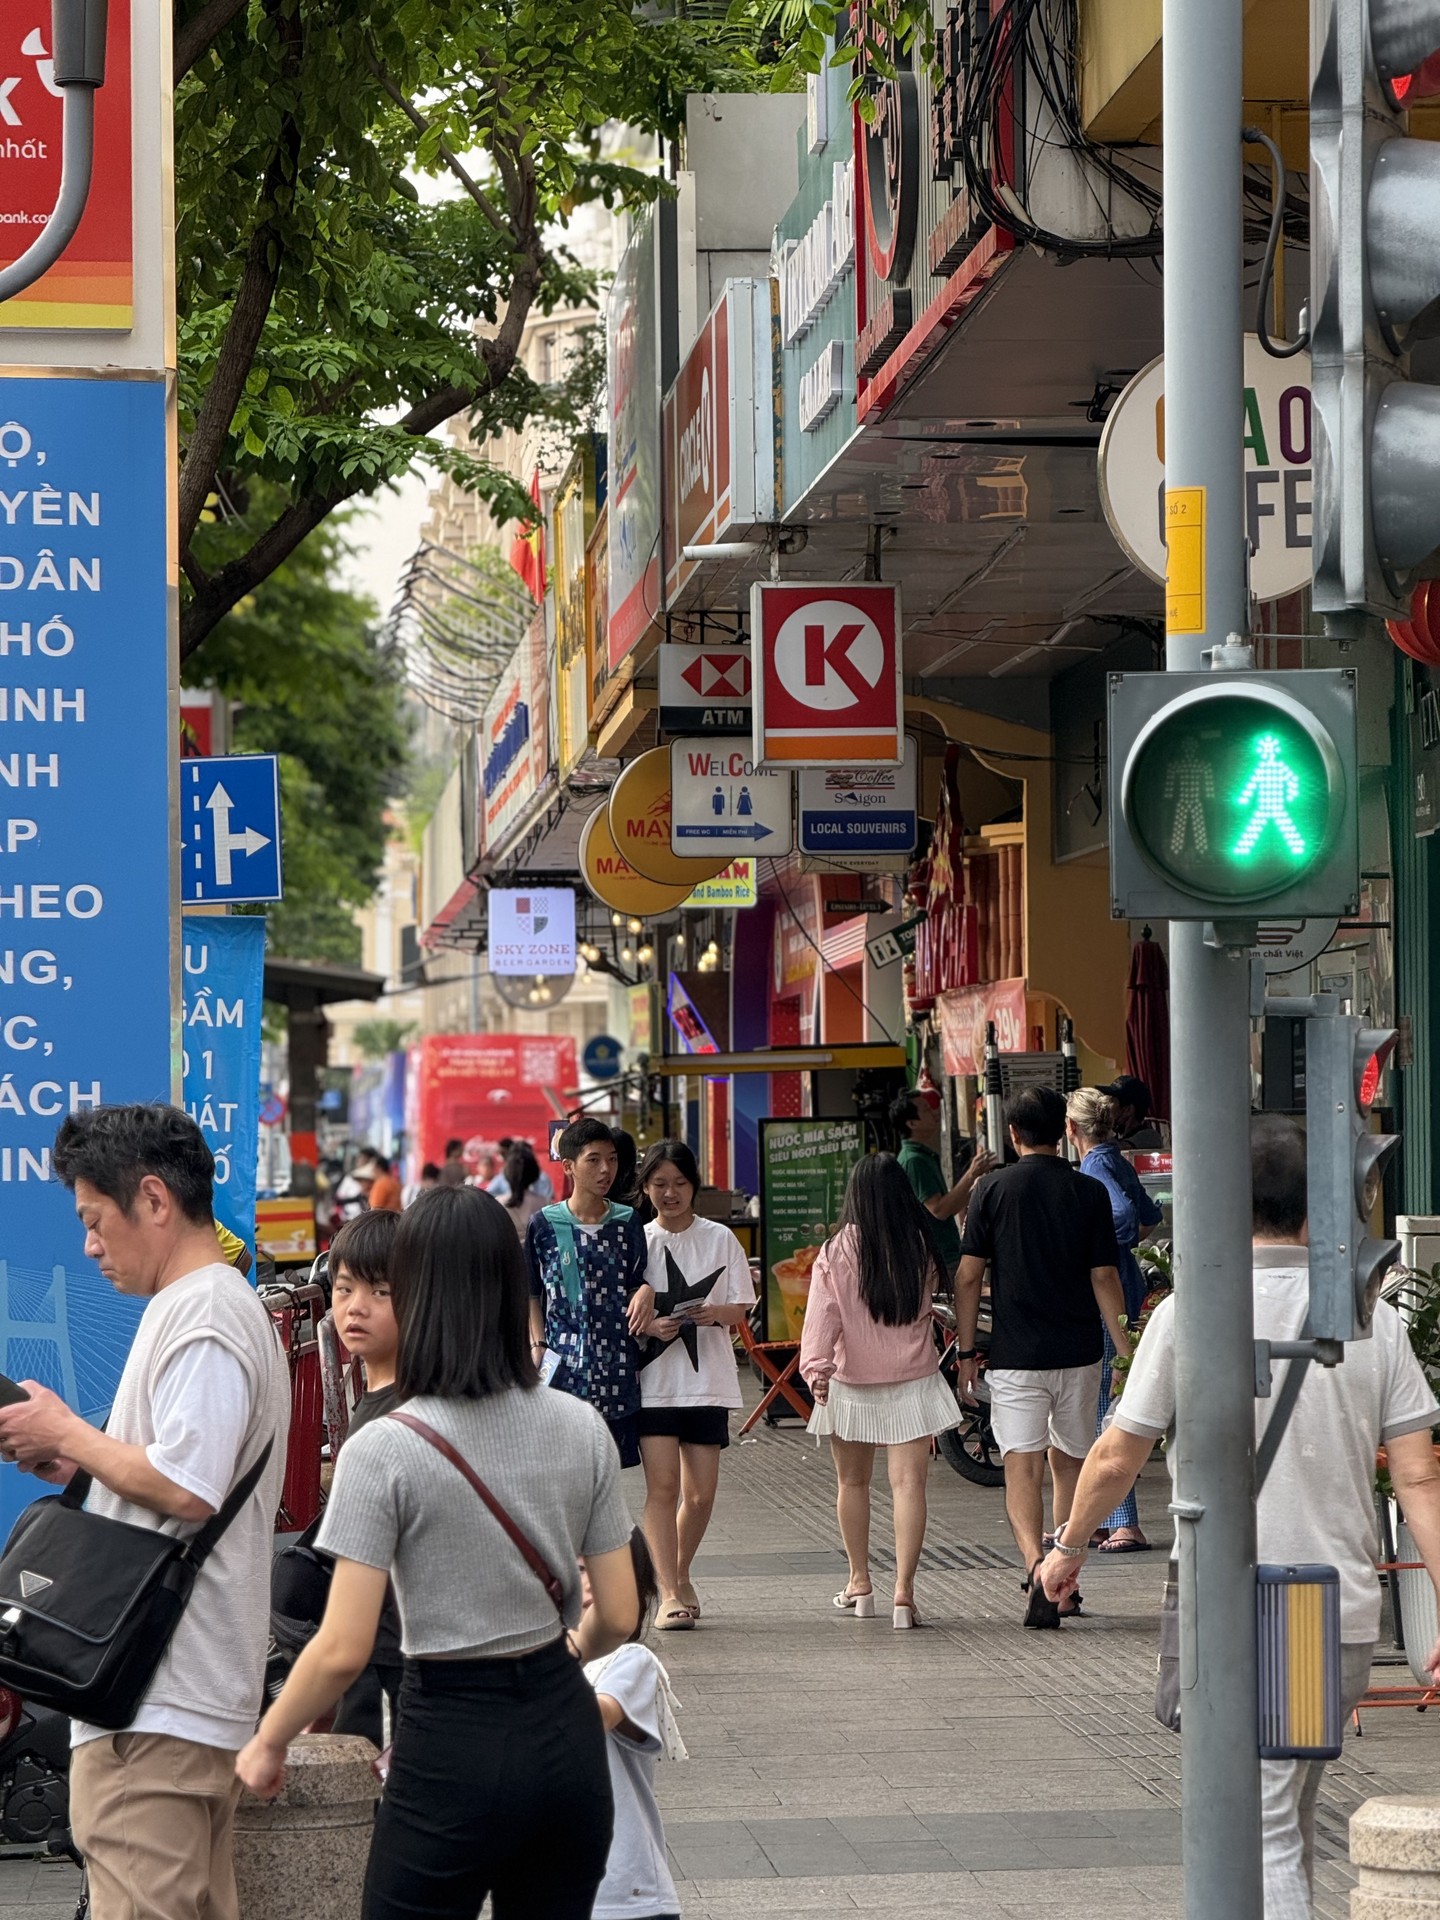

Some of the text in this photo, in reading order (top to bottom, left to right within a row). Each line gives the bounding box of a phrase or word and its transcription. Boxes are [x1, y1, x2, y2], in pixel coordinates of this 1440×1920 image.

[702, 710, 744, 725] ATM
[855, 769, 895, 787] Coffee
[811, 823, 907, 834] LOCAL SOUVENIRS
[707, 886, 732, 898] Bamboo
[735, 886, 750, 897] Rice
[495, 944, 570, 955] SKY ZONE
[1286, 949, 1304, 958] Việt
